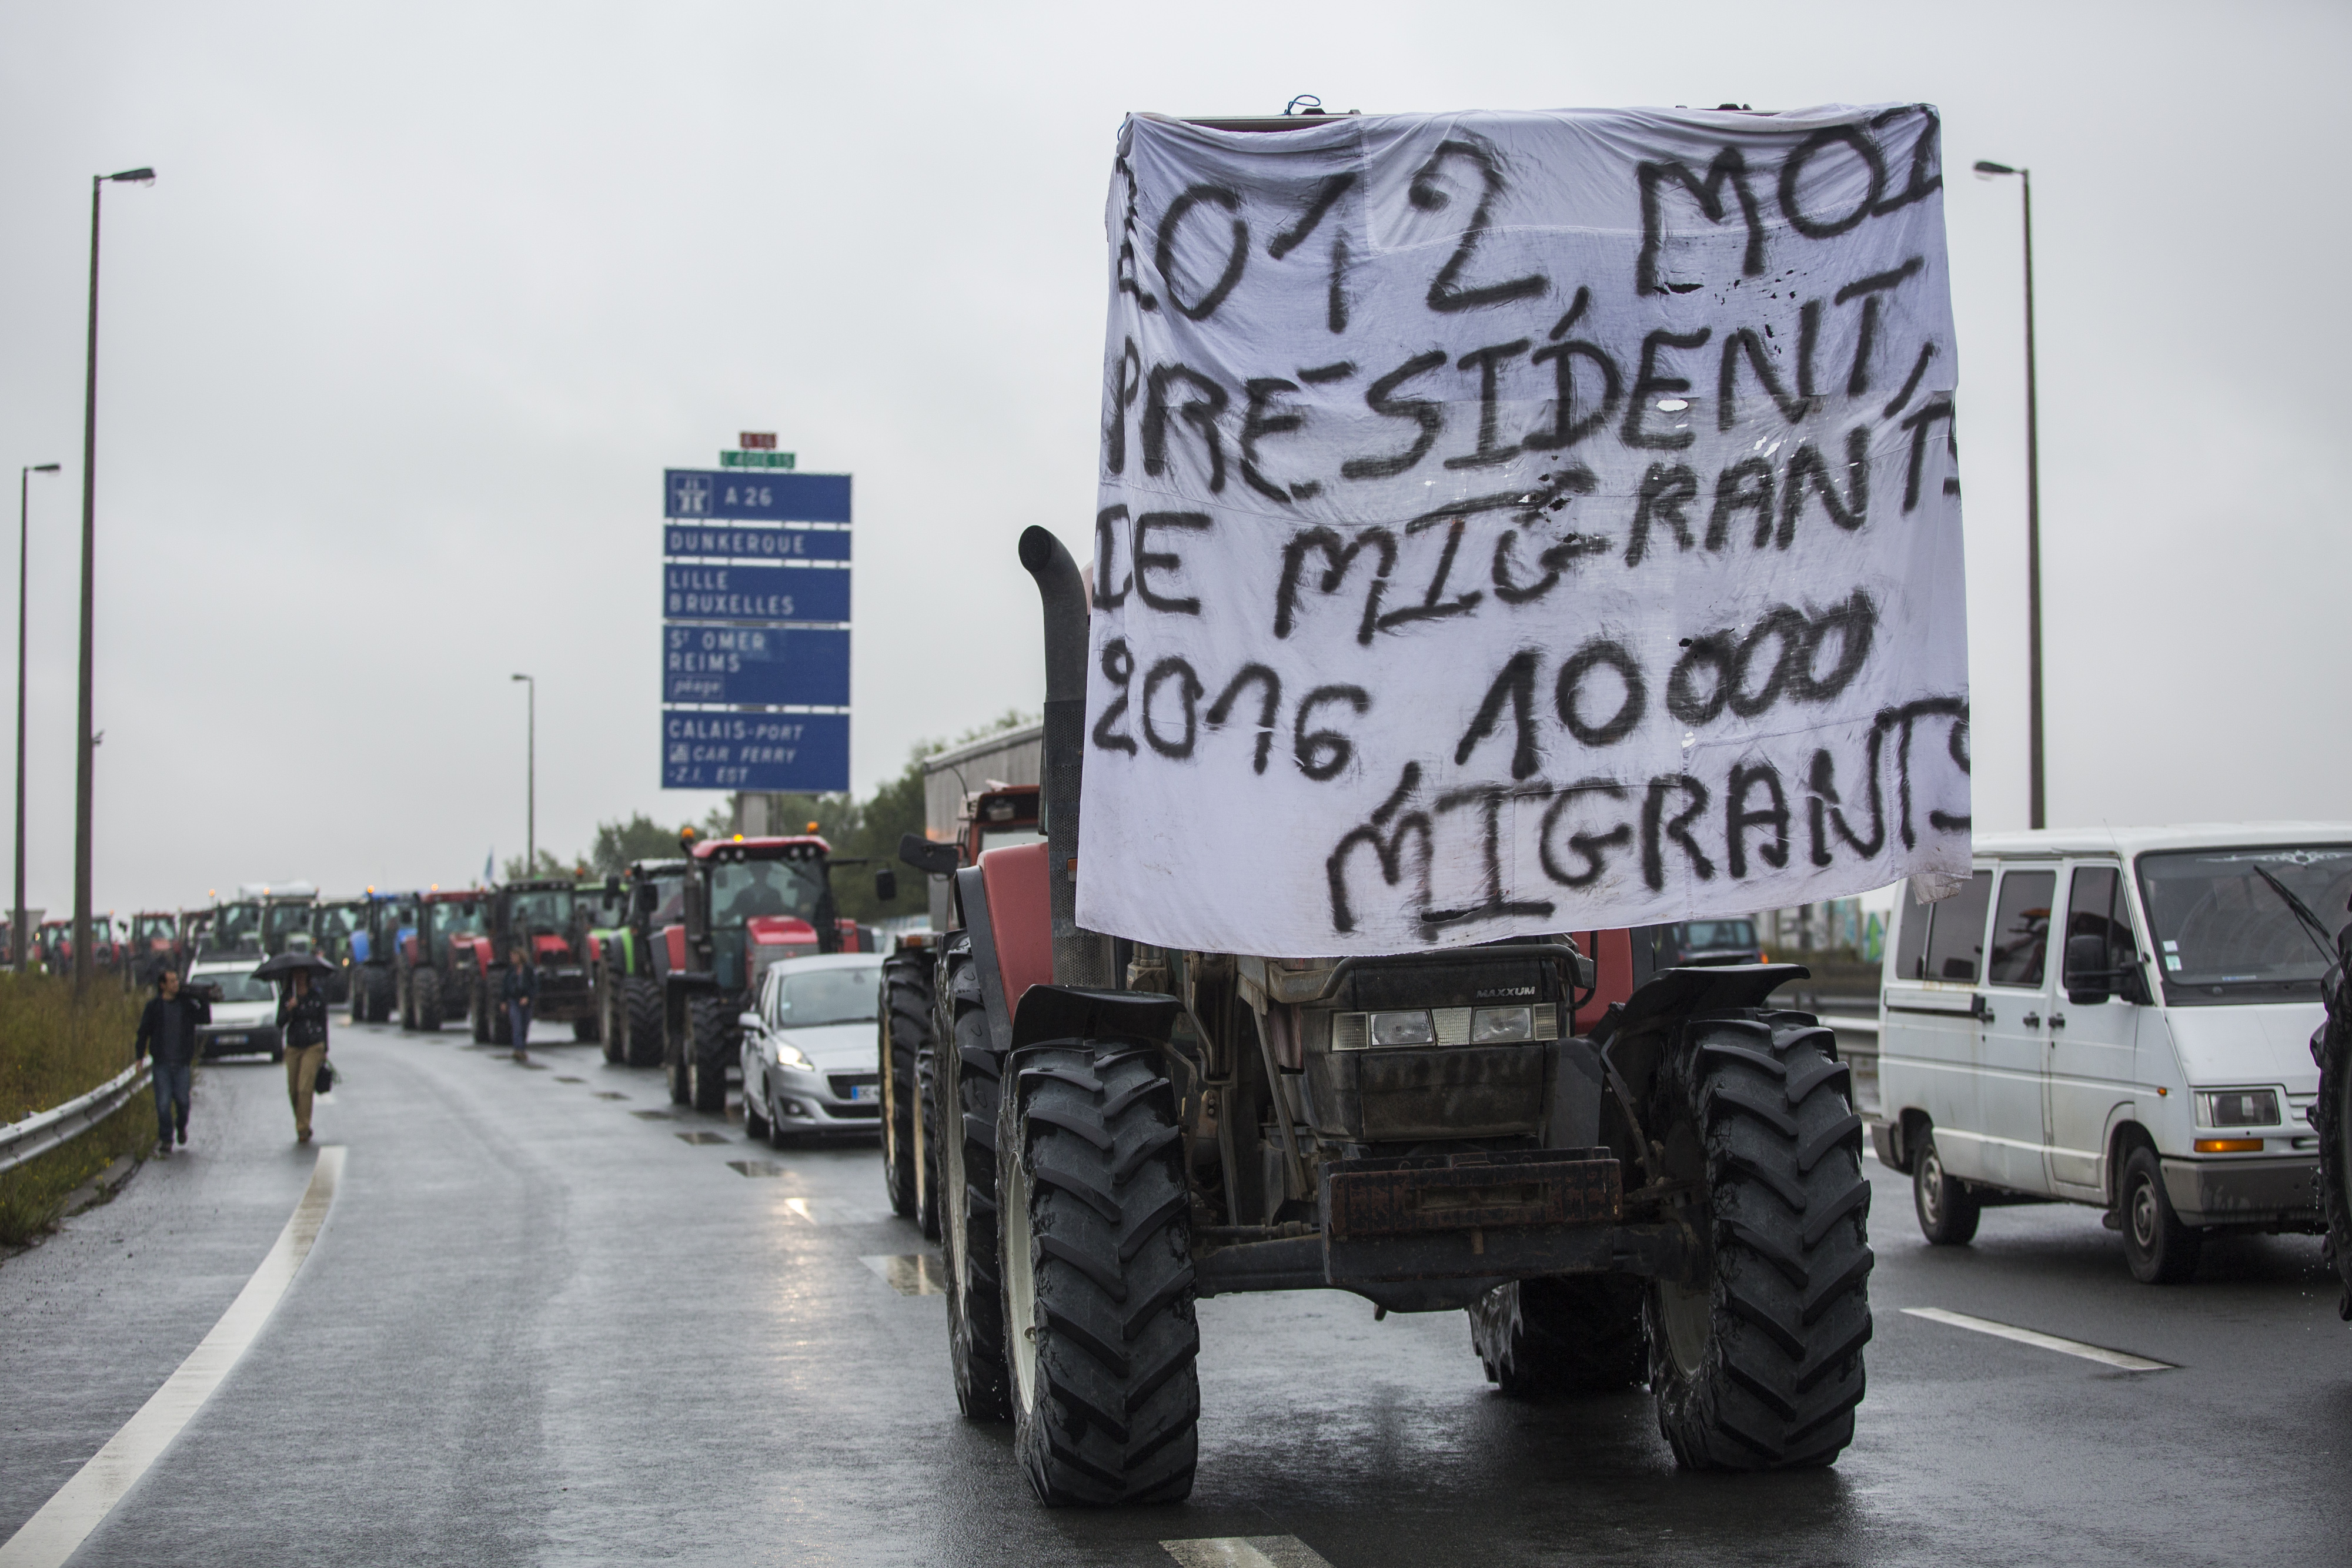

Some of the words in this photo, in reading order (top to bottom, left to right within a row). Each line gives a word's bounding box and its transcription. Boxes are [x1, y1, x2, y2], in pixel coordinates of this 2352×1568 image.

[1636, 106, 1942, 296] MOI
[724, 486, 738, 506] A
[744, 486, 773, 507] 26
[669, 531, 805, 554] DUNKERQUE
[669, 570, 727, 590] LILLE
[669, 593, 794, 616] BRUXELLES
[702, 631, 765, 651] OMER
[669, 651, 741, 672] REIMS
[692, 744, 730, 762] CAR
[740, 745, 797, 764] FERRY
[716, 765, 749, 784] EST
[1476, 986, 1536, 999] MAXXUM
